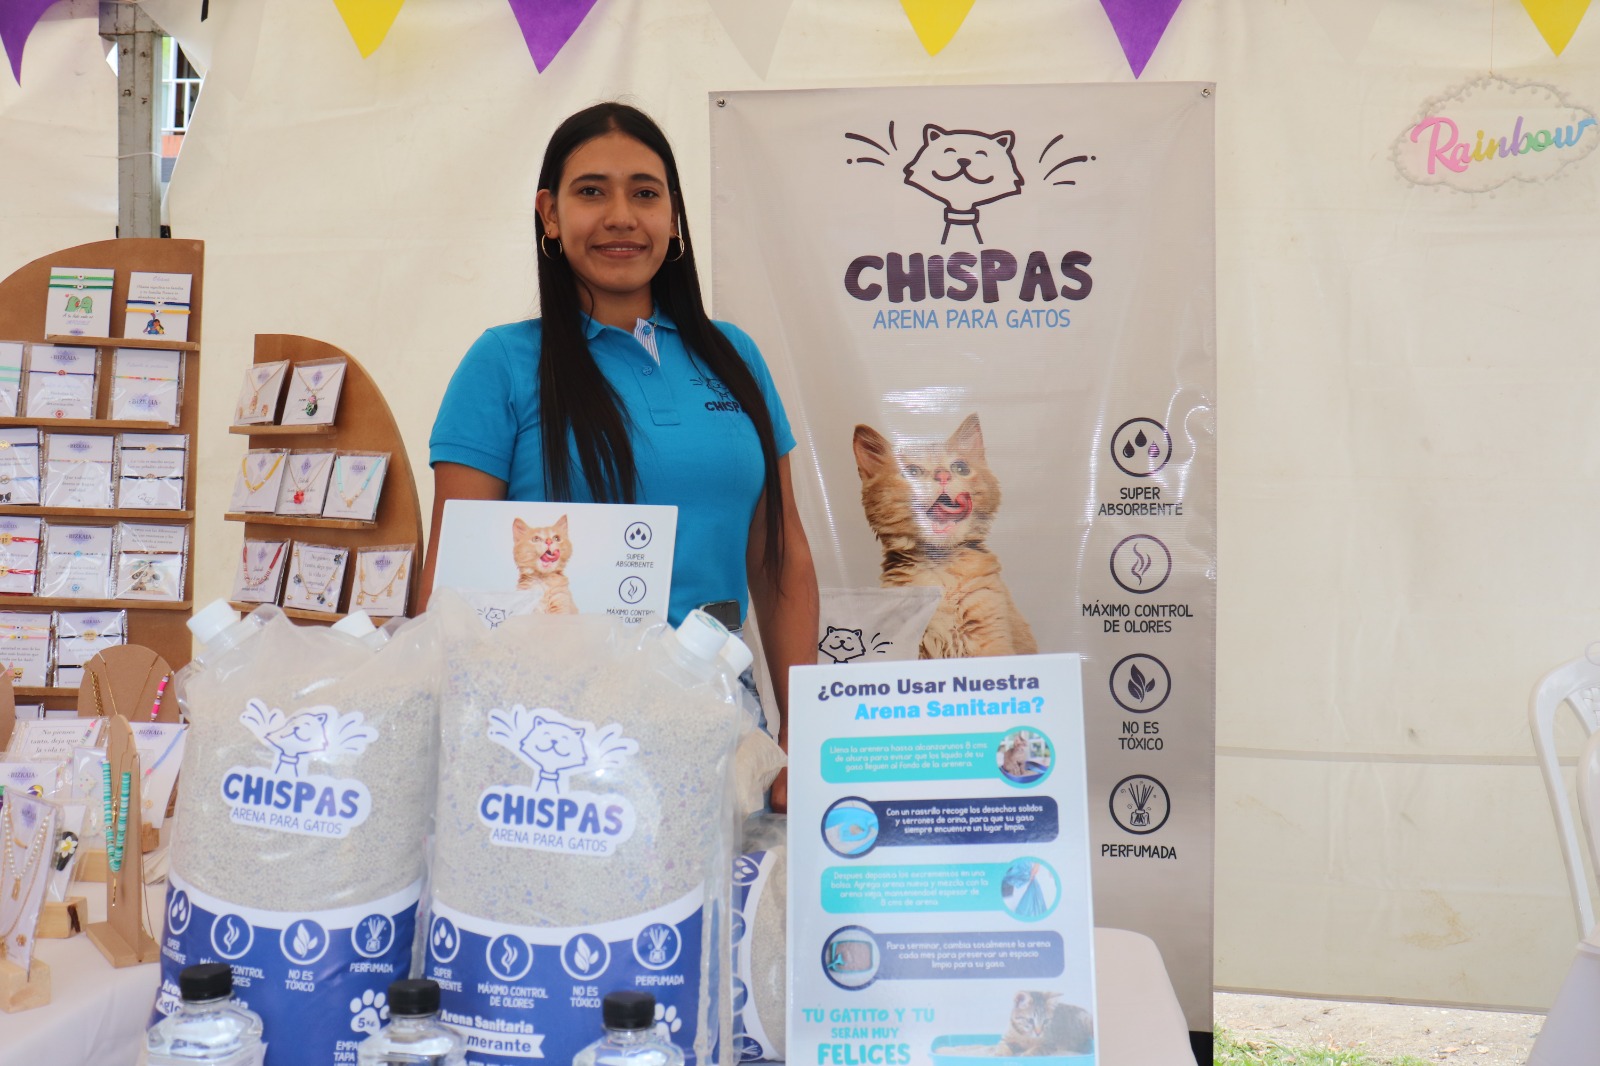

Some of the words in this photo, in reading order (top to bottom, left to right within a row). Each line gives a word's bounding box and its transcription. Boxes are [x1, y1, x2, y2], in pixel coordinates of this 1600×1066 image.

[1410, 116, 1596, 174] Rainbow
[844, 249, 1092, 303] CHISPAS
[872, 309, 938, 330] ARENA
[946, 309, 998, 329] PARA
[1006, 308, 1070, 329] GATOS
[704, 401, 741, 414] CHISP
[1120, 487, 1160, 500] SUPER
[1098, 503, 1183, 516] ABSORBENTE
[1082, 600, 1130, 616] MÁXIMO
[1134, 604, 1194, 618] CONTROL
[1104, 620, 1120, 633] DE
[1124, 620, 1172, 633] OLORES
[817, 681, 890, 702] ¿Como
[897, 677, 946, 695] Usar
[952, 674, 1040, 692] Nuestra
[855, 702, 920, 720] Arena
[926, 696, 1045, 718] Sanitaria?
[1122, 721, 1139, 734] NO
[1144, 721, 1159, 734] ES
[1118, 734, 1164, 750] TÓXICO
[224, 774, 359, 818] CHISPAS
[481, 794, 624, 835] CHISPAS
[886, 808, 899, 816] Con
[911, 806, 940, 815] rastrillo
[942, 808, 968, 816] recoge
[982, 805, 1017, 814] desechos
[232, 807, 266, 824] ARENA
[269, 812, 299, 830] PARA
[303, 818, 342, 834] GATOS
[895, 819, 900, 827] y
[969, 816, 989, 825] para
[990, 816, 1003, 824] que
[1016, 815, 1034, 823] gato
[904, 826, 933, 835] siempre
[983, 824, 1002, 833] lugar
[492, 828, 529, 844] ARENA
[533, 833, 564, 848] PARA
[568, 837, 607, 852] GATOS
[1101, 844, 1177, 859] PERFUMADA
[886, 941, 905, 950] Para
[899, 951, 919, 959] cada
[937, 952, 956, 960] para
[350, 963, 393, 973] PERFUMADA
[954, 961, 973, 970] para
[288, 970, 301, 979] NO
[302, 971, 313, 980] ES
[635, 974, 684, 987] PERFUMADA
[285, 978, 315, 992] TÓXICO
[478, 981, 508, 995] MÁXIMO
[510, 986, 549, 999] CONTROL
[572, 986, 584, 996] NO
[586, 986, 598, 996] ES
[490, 996, 502, 1007] DE
[503, 998, 535, 1009] OLORES
[570, 995, 601, 1008] TÓXICO
[441, 1009, 473, 1026] Arena
[474, 1016, 534, 1034] Sanitaria
[830, 1008, 890, 1023] GATITO
[894, 1008, 906, 1022] Y
[872, 1028, 899, 1039] MUY
[336, 1040, 358, 1051] EMPA
[467, 1035, 531, 1052] merante
[334, 1052, 355, 1062] TAPA
[818, 1043, 911, 1065] FELICES
